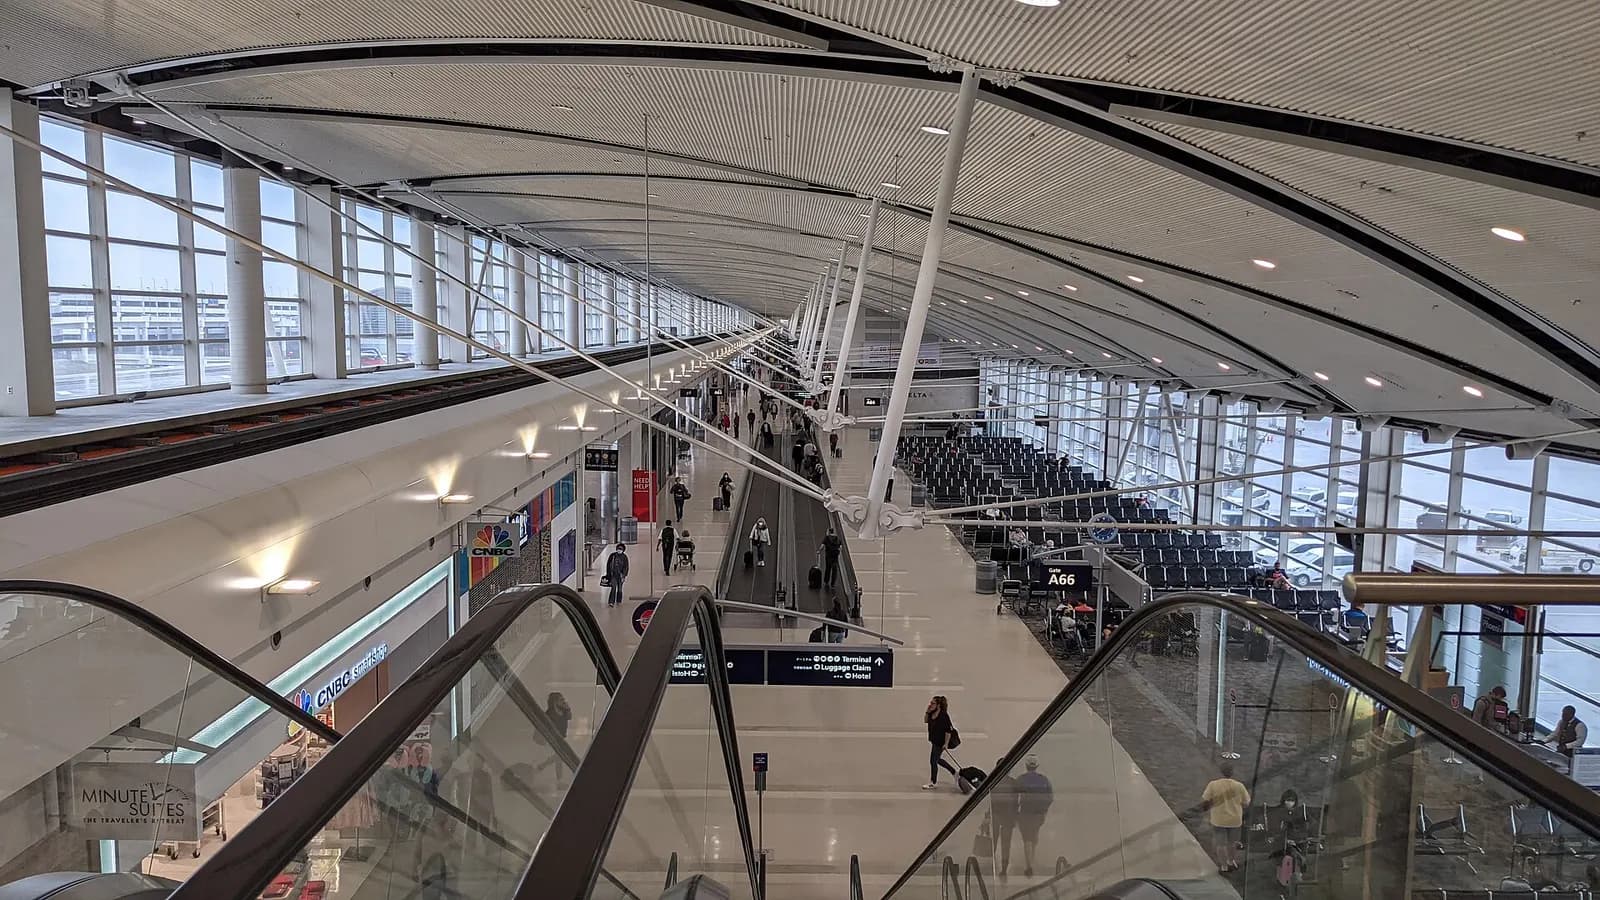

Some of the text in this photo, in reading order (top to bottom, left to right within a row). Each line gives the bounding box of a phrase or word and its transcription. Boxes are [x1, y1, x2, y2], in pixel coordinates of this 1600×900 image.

[472, 547, 515, 556] CNBC
[1048, 573, 1075, 585] A66
[821, 664, 851, 672] Luggage
[317, 671, 350, 707] CNBC
[82, 789, 148, 803] MINUTE
